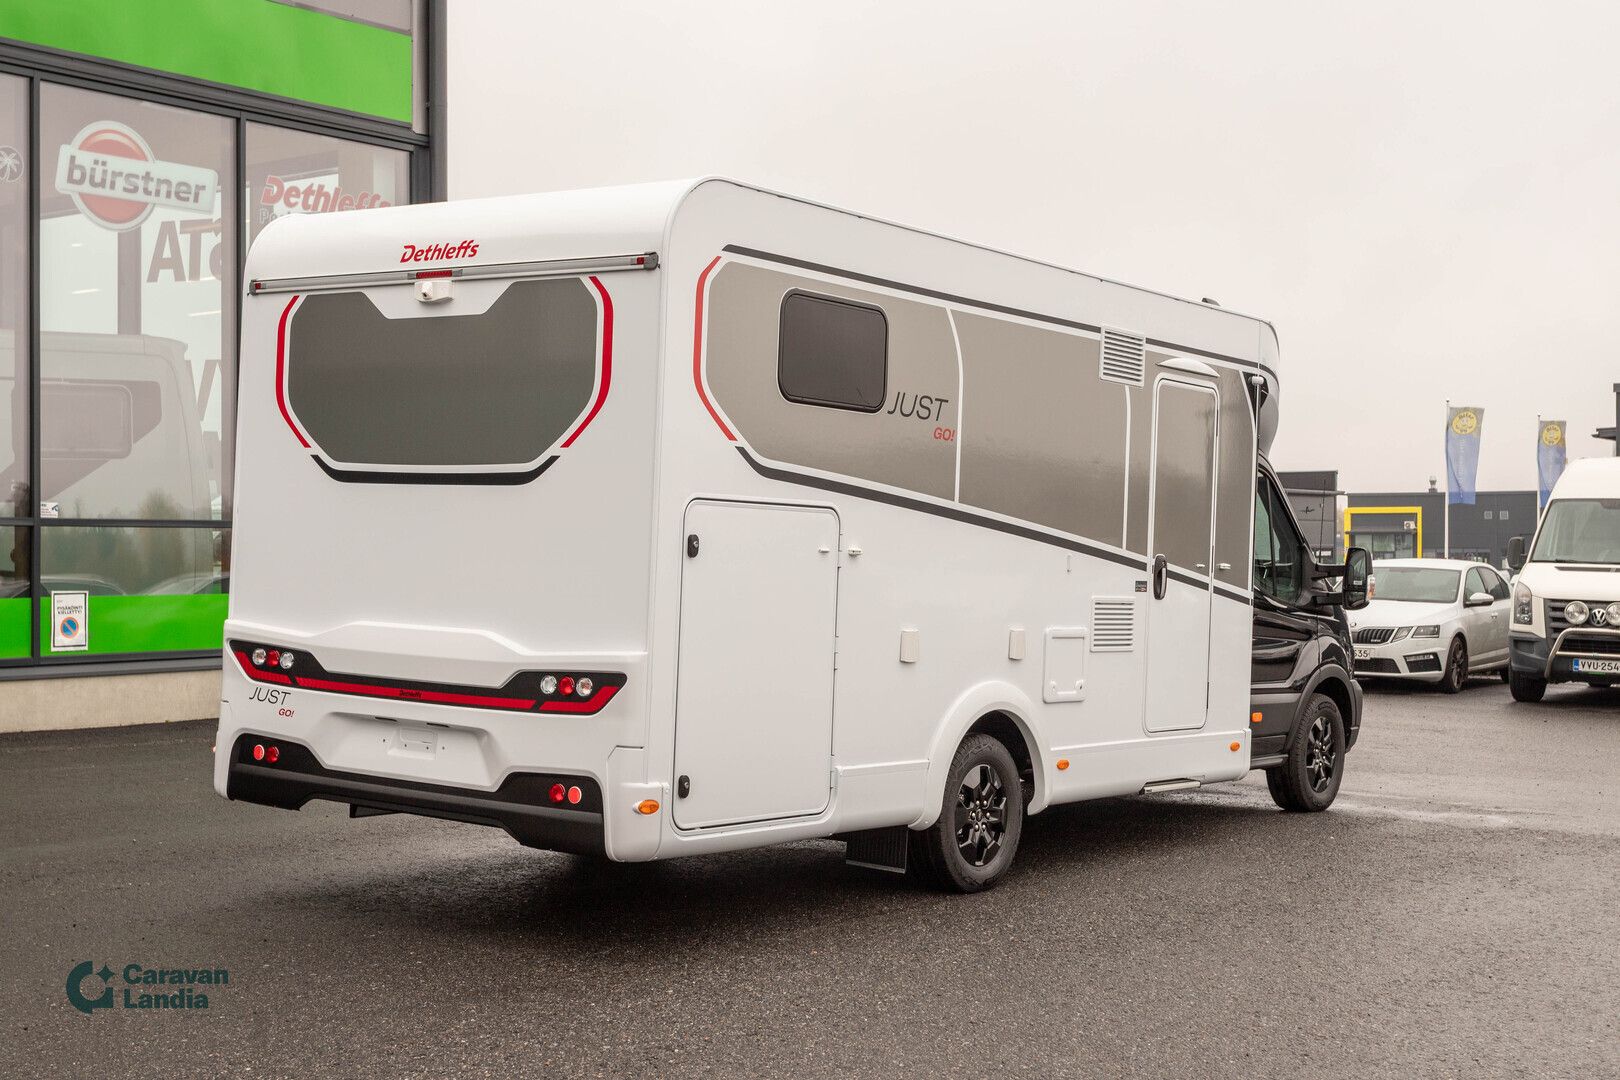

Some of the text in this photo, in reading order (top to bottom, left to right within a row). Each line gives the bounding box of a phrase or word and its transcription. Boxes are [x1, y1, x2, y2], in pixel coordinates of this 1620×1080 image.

[66, 155, 206, 204] bürstner
[400, 239, 479, 263] Dethleffs
[887, 392, 948, 421] JUST
[933, 427, 955, 441] GO!
[1581, 661, 1620, 671] VVU-254
[249, 687, 291, 705] JUST
[278, 708, 294, 717] GO!
